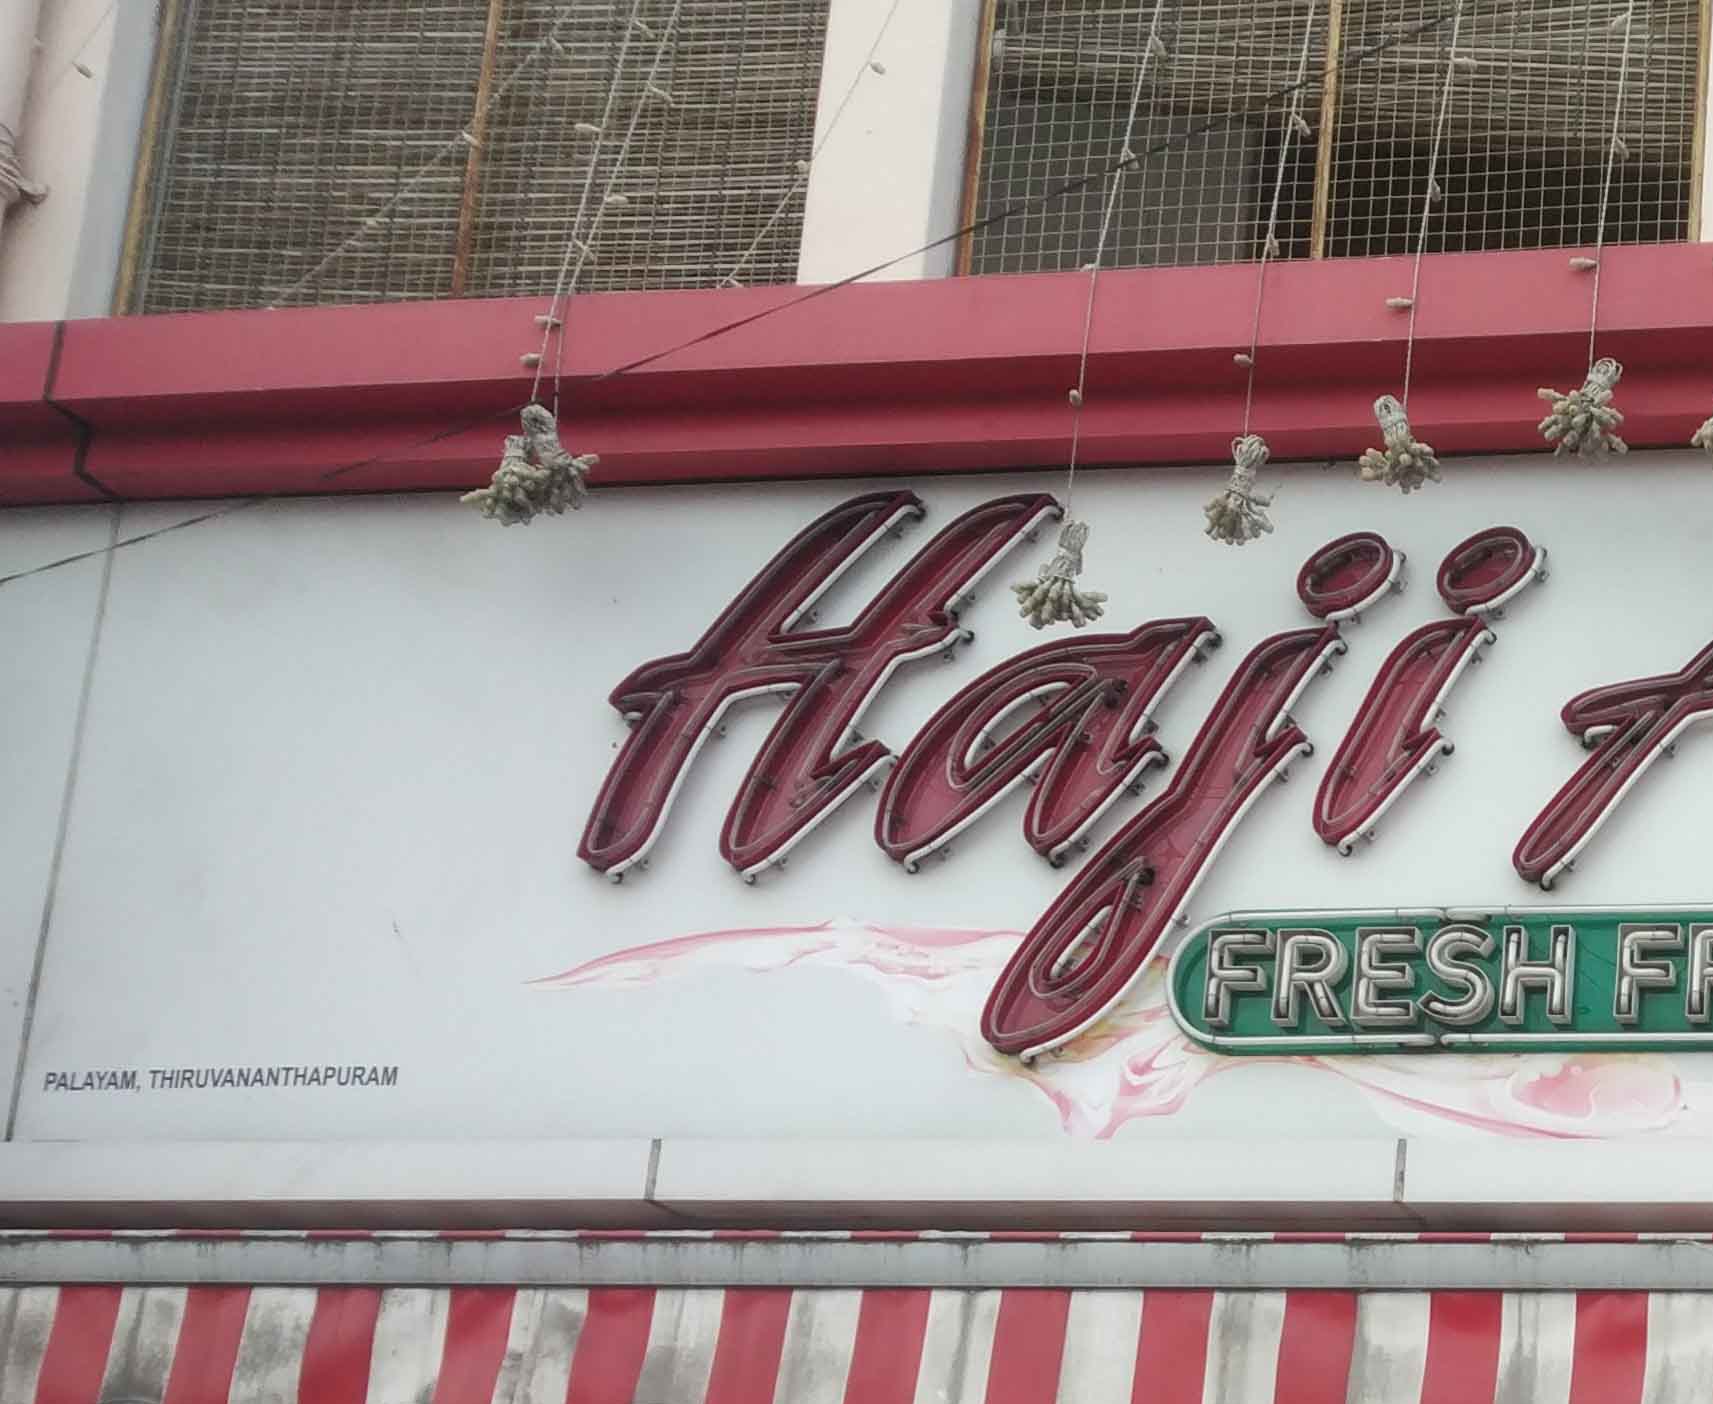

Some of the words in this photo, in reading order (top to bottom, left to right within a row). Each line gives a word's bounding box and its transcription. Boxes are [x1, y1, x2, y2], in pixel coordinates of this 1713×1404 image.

[577, 489, 1550, 1064] Haji
[1202, 923, 1576, 1030] FRESH
[43, 1070, 142, 1093] PALAYAM,
[148, 1066, 399, 1090] THIRUVANANTHAPURAM
